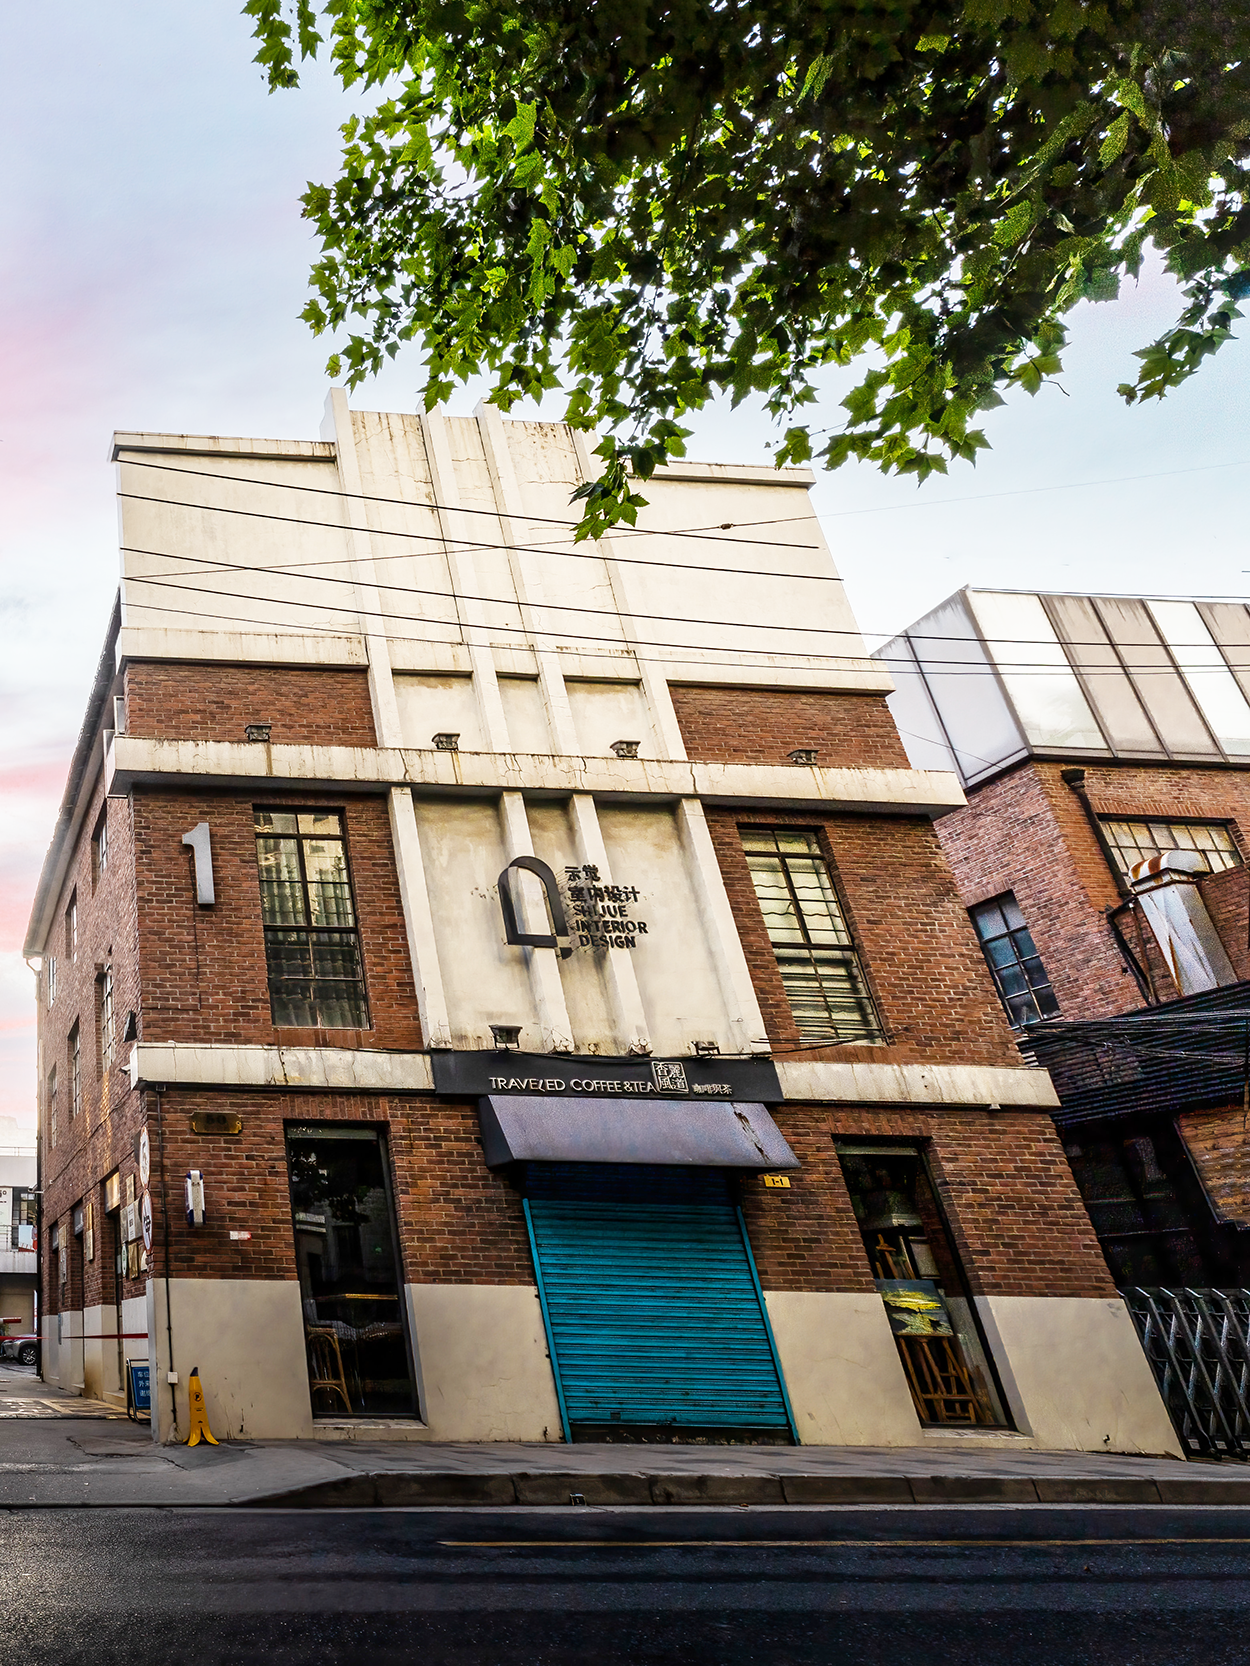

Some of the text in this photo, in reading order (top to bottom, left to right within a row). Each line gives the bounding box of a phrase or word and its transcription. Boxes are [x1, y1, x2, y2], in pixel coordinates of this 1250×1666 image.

[182, 822, 215, 905] 1
[565, 864, 601, 882] 示觉
[568, 885, 641, 903] 室内设计
[572, 904, 629, 918] SHIJUE
[575, 920, 649, 934] INTERIOR
[578, 935, 637, 949] DESIGN
[488, 1077, 566, 1092] TRAVELED
[570, 1078, 623, 1093] COFFEE
